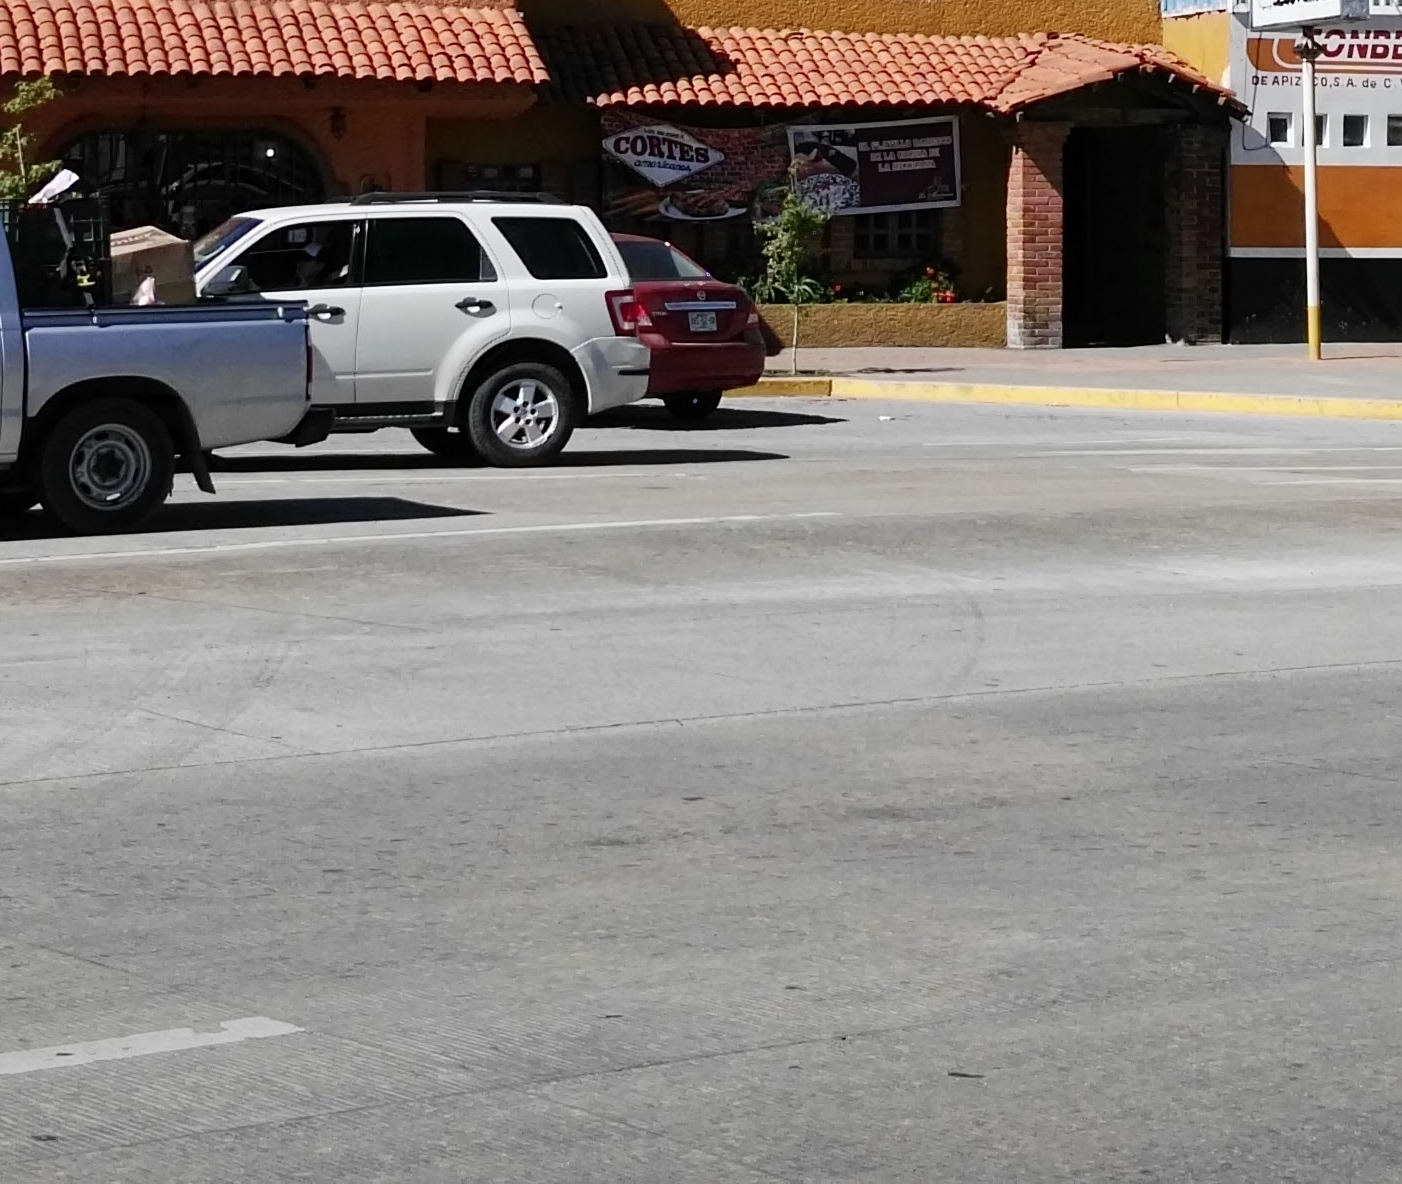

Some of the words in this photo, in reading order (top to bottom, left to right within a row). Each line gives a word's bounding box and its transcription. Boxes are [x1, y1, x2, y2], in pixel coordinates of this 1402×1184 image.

[1252, 75, 1268, 86] DE
[1362, 78, 1377, 88] de
[613, 135, 710, 164] CORTES
